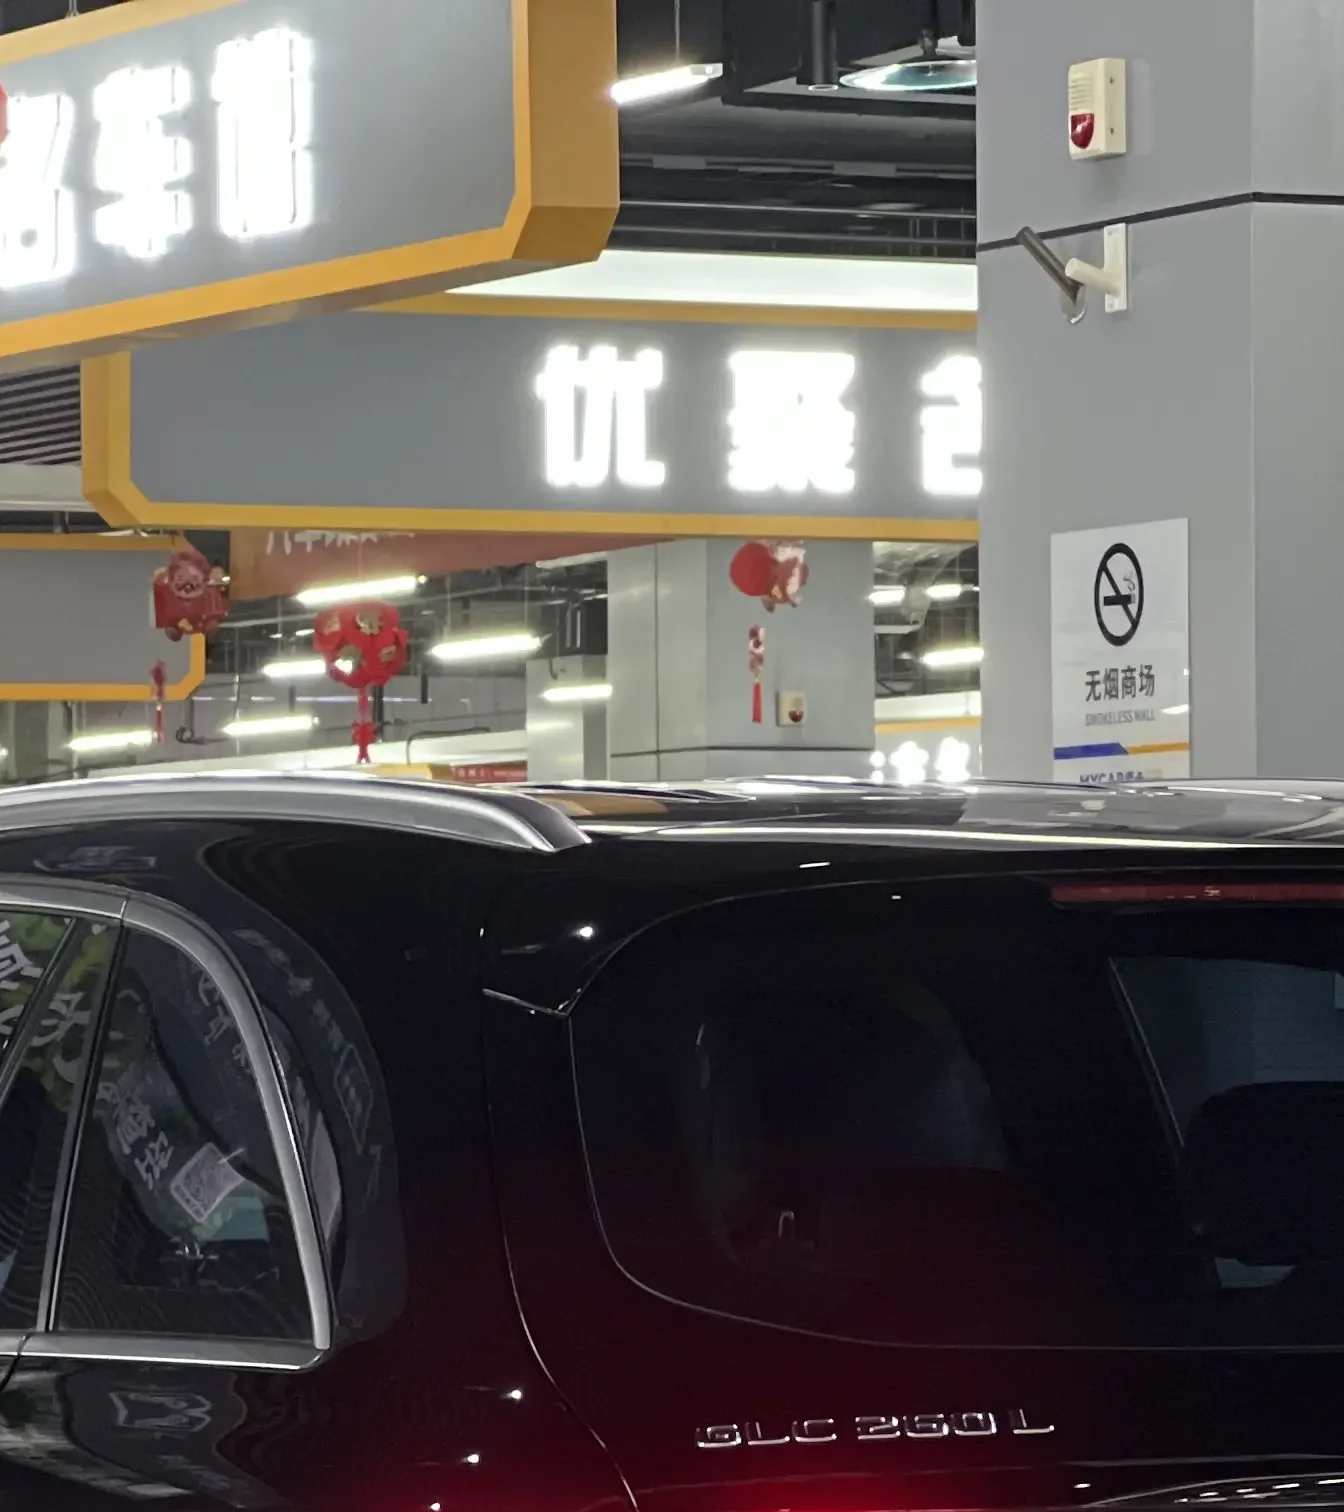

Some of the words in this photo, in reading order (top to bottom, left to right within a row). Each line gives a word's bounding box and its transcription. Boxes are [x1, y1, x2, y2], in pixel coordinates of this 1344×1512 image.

[1085, 664, 1155, 702] 无烟商场
[696, 1418, 839, 1450] GLC
[1006, 1408, 1056, 1435] L
